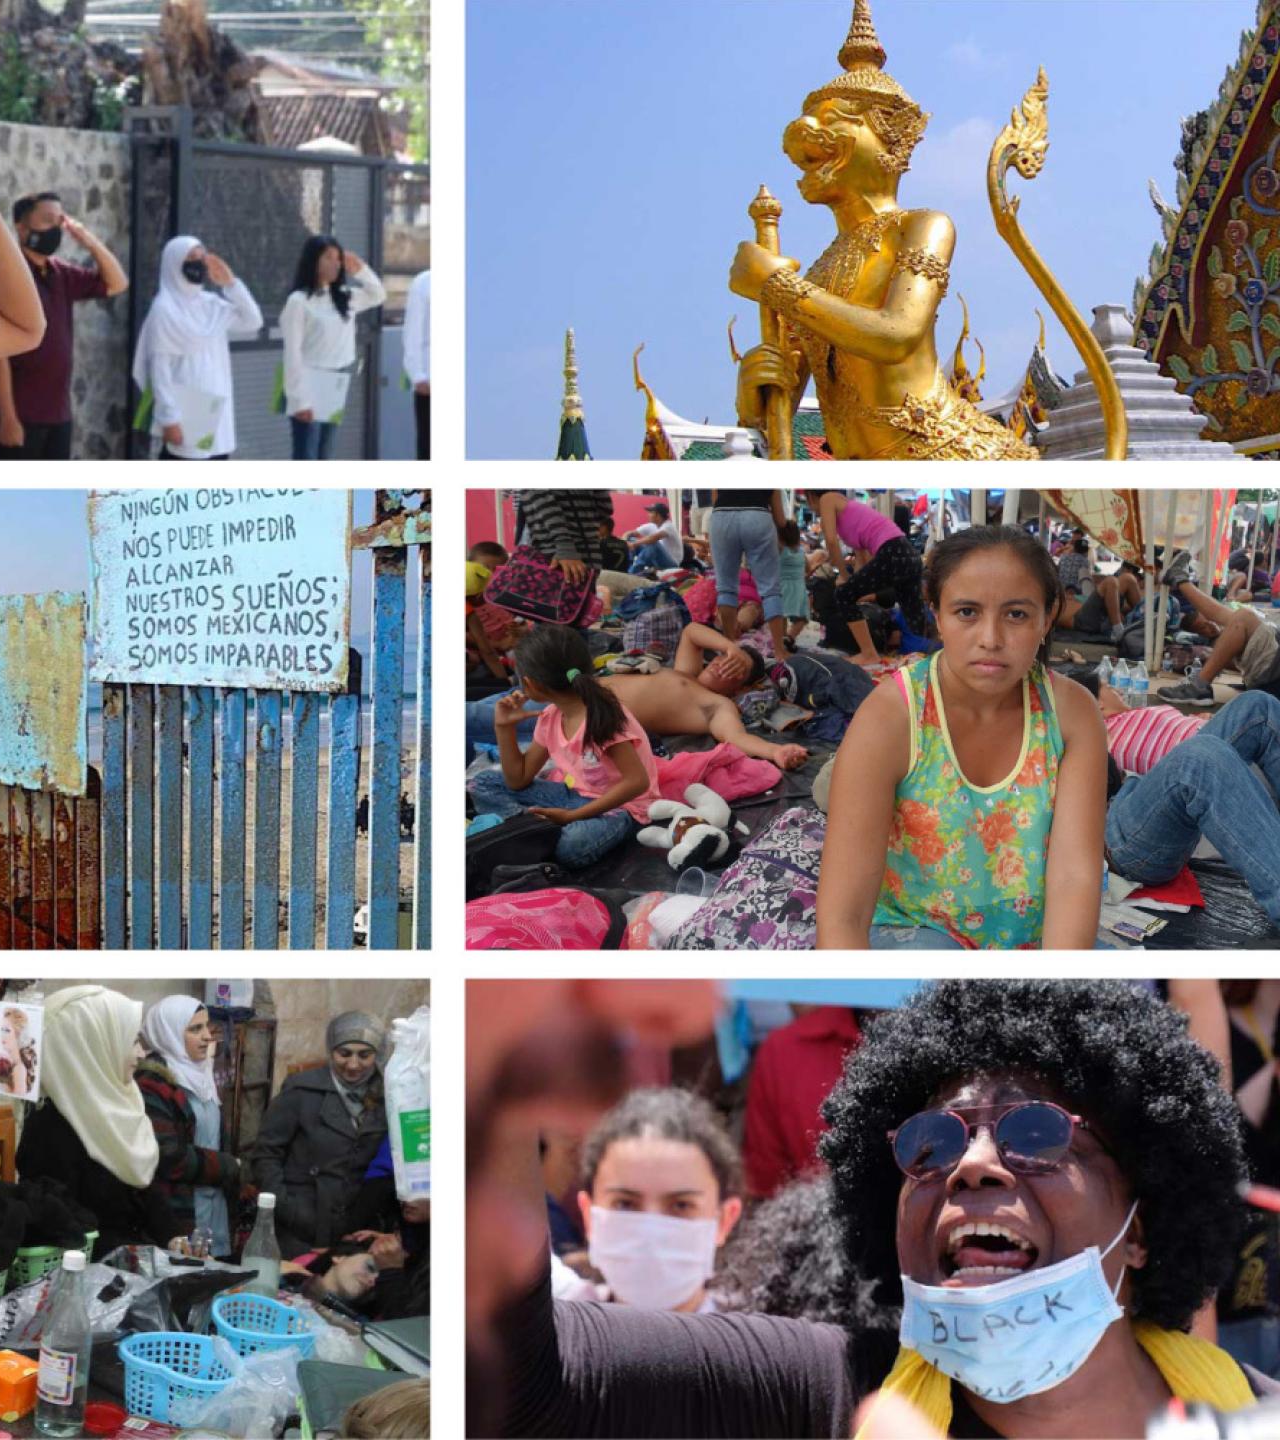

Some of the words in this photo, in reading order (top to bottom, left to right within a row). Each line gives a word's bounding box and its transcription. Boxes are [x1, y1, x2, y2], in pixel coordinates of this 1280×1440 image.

[121, 488, 188, 522] NINGÚN
[123, 531, 162, 561] NOS
[167, 524, 214, 553] PUEDE
[222, 513, 296, 547] IMPEDIR
[125, 555, 234, 588] ALCANZAR
[125, 584, 225, 614] NUESTROS
[128, 614, 198, 640] SOMOS
[206, 610, 339, 643] MEXICANOS,
[128, 643, 198, 671] SOMOS
[205, 643, 333, 675] IMPARABLES
[928, 1291, 1072, 1343] BLACK
